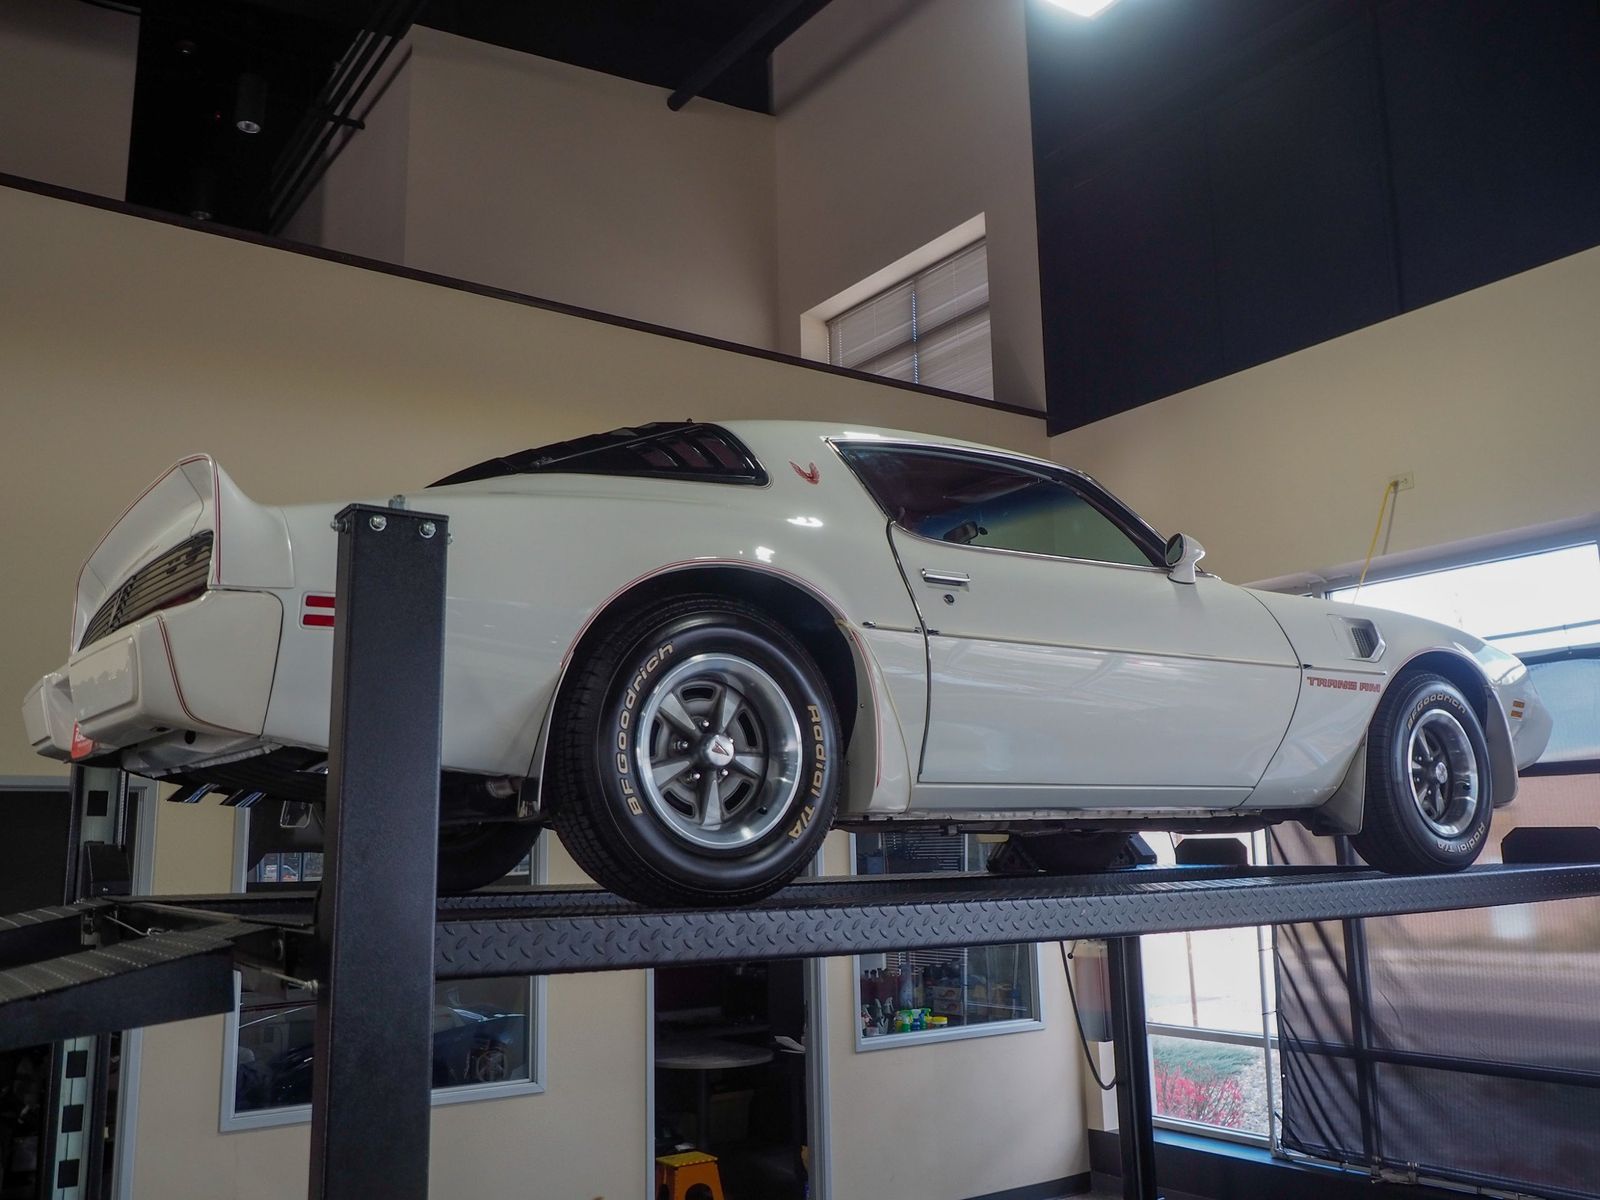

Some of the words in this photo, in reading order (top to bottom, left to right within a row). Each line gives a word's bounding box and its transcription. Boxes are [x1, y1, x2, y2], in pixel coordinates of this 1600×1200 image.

[1307, 676, 1357, 691] TRANS
[1359, 682, 1381, 693] AM
[807, 704, 826, 799] Radial
[788, 806, 816, 839] T/A
[1457, 821, 1486, 853] Radial
